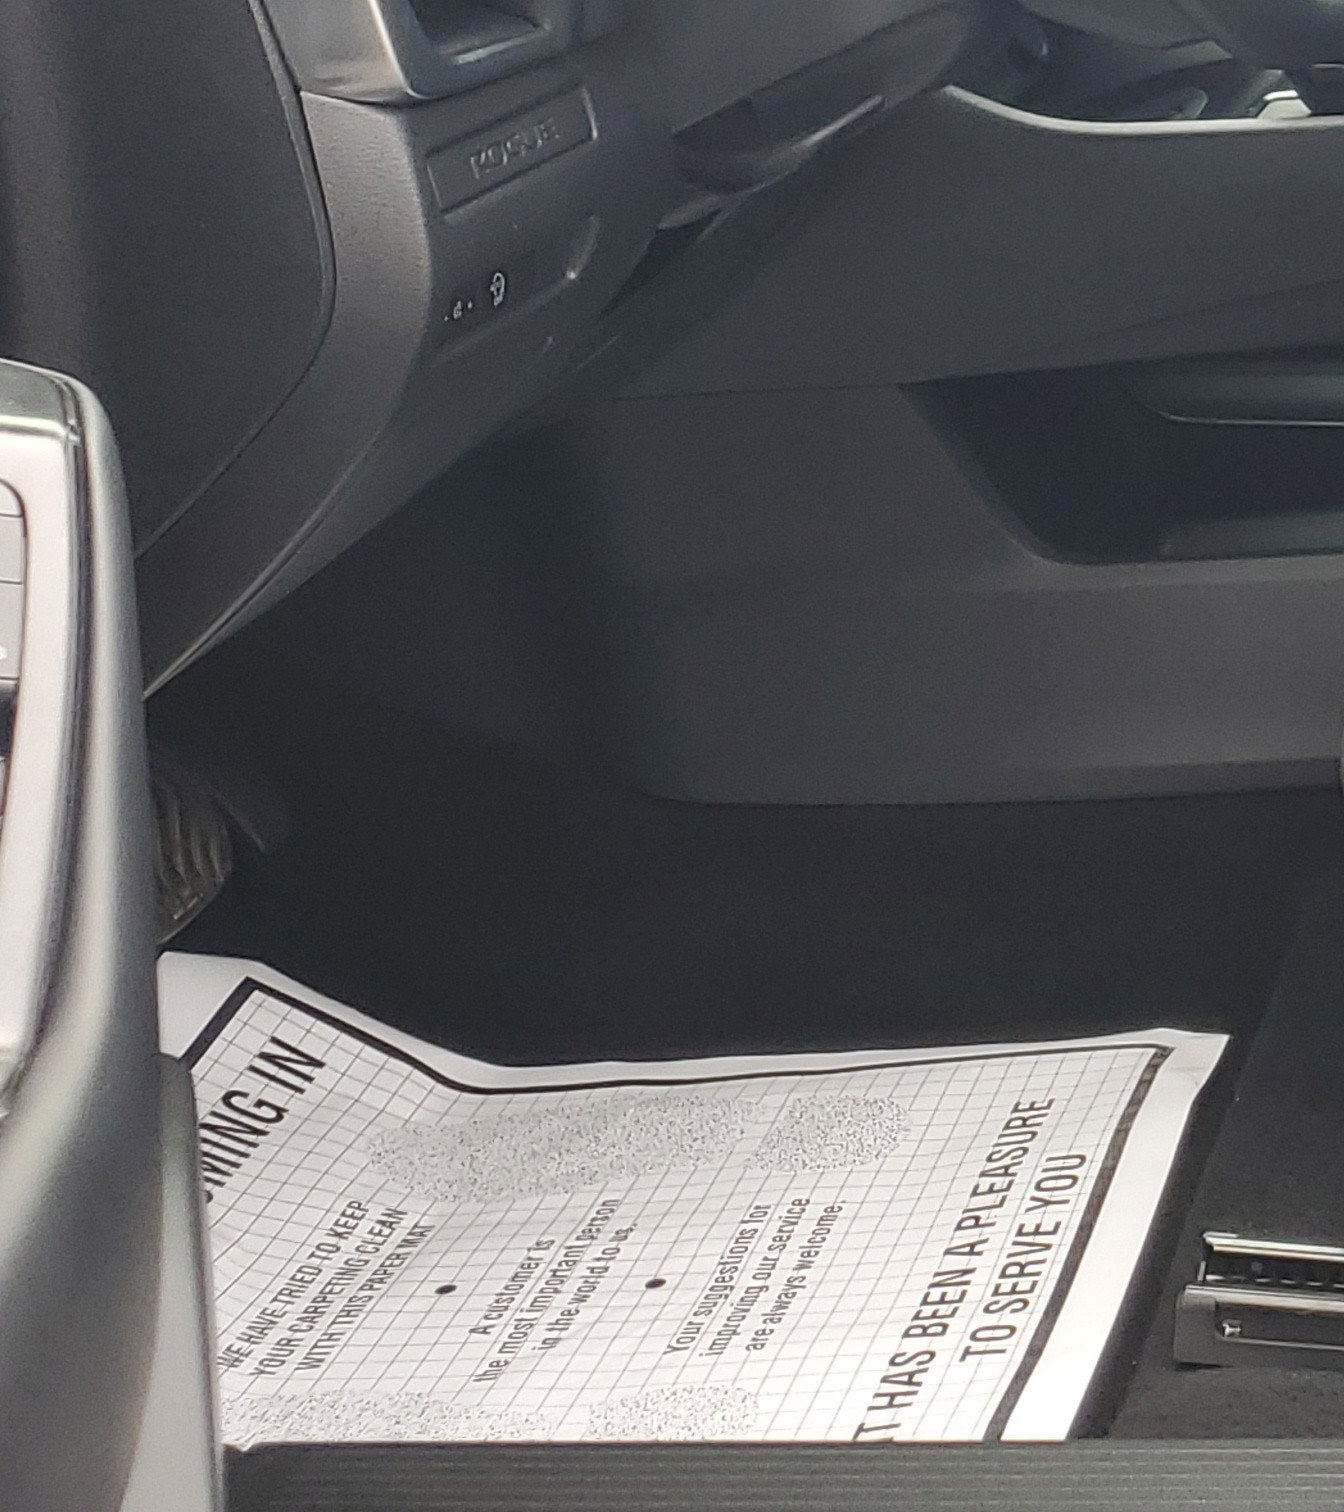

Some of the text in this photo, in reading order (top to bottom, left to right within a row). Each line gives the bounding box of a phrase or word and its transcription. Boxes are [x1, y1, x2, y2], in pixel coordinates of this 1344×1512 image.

[247, 1035, 326, 1095] IN
[954, 1097, 1055, 1232] PLEASURE
[217, 1200, 369, 1369] WE HAVE TRIED TO KEEP
[249, 1207, 408, 1376] YOUR CARPETING CLEAN
[295, 1222, 436, 1370] WITH THIS PAPER MAT
[468, 1239, 555, 1335] A customer is
[473, 1198, 621, 1383] the most important person
[531, 1337, 558, 1351] in
[545, 1308, 581, 1332] the
[567, 1265, 611, 1305] world
[593, 1246, 621, 1261] to
[662, 1204, 771, 1355] Your suggestions for
[699, 1197, 810, 1357] improving our service
[745, 1327, 774, 1351] are
[761, 1275, 807, 1325] always
[901, 1267, 977, 1340] BEEN
[943, 1238, 989, 1256] A
[959, 1152, 1088, 1363] TO SERVE YOU
[867, 1350, 936, 1412] HAS
